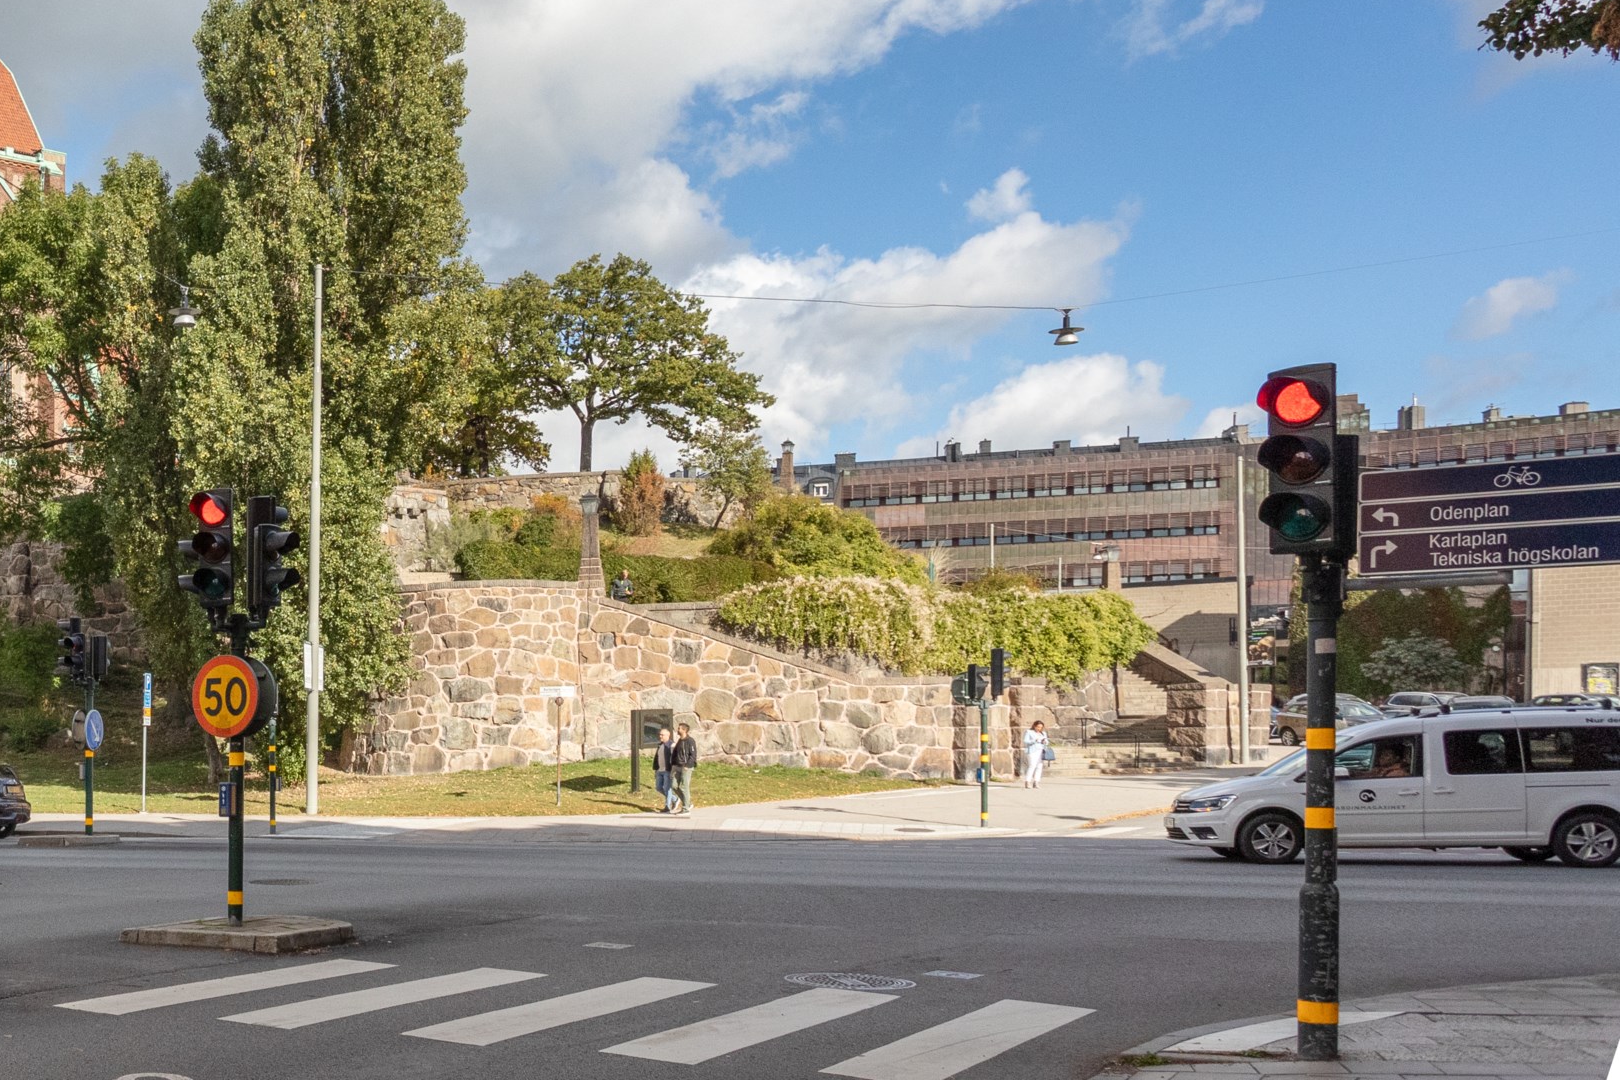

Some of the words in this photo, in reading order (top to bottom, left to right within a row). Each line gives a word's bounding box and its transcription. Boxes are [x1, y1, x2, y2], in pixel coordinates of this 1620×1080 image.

[1430, 504, 1510, 521] Odenplan
[1429, 531, 1508, 549] Karlaplan
[1430, 550, 1502, 567] Tekniska
[1508, 544, 1600, 565] högskolan
[204, 676, 248, 717] 50
